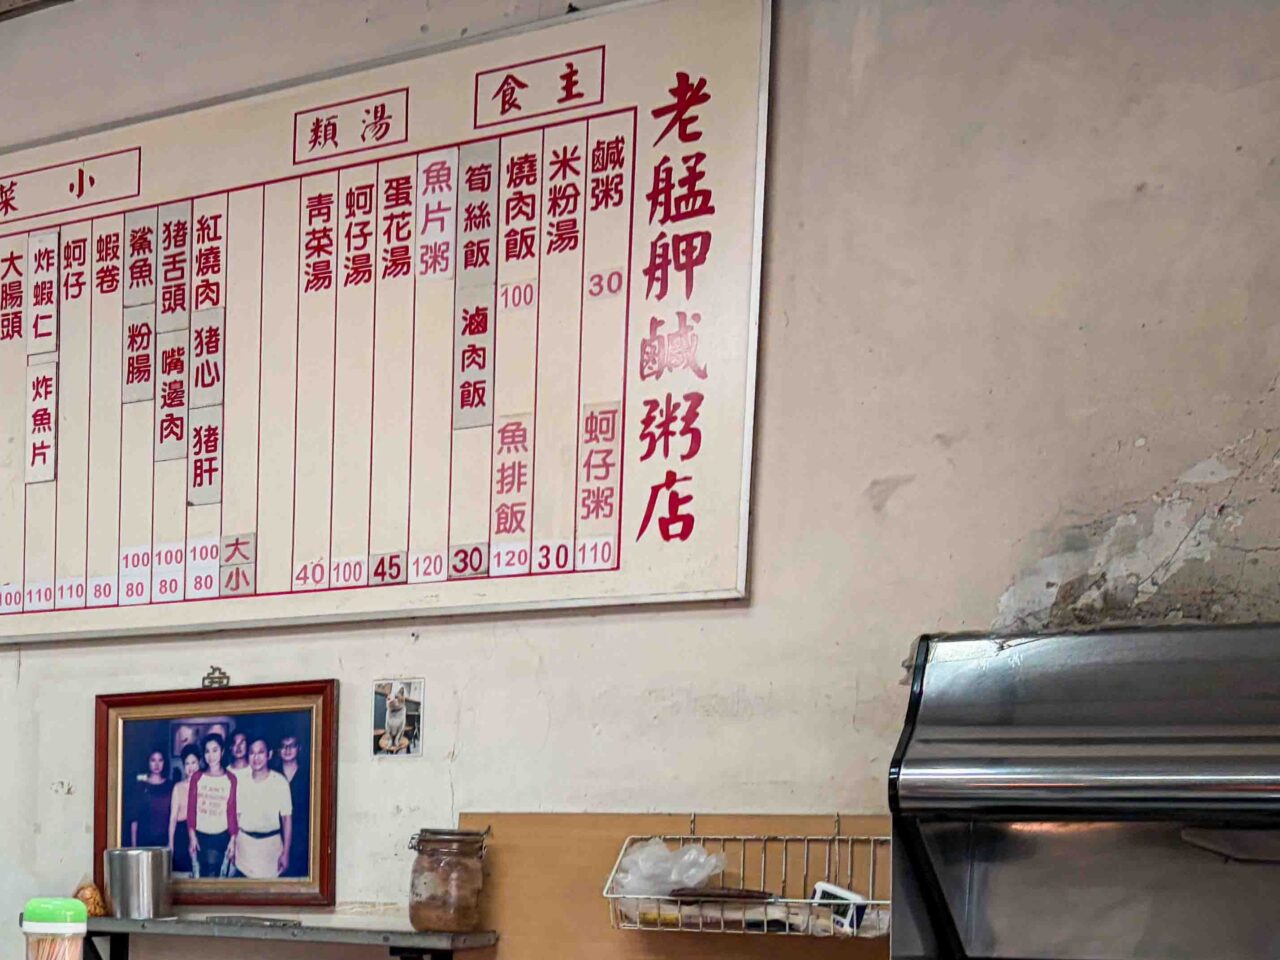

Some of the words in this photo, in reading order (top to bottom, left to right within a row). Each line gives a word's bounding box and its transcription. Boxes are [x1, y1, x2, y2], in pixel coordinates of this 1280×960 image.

[590, 135, 625, 212] 鹹粥
[504, 153, 538, 263] 燒肉飯
[546, 145, 582, 256] 米粉湯
[381, 175, 412, 280] 蛋花湯
[419, 160, 453, 276] 魚片粥
[463, 164, 492, 270] 筍絲飯
[304, 193, 334, 293] 青菜湯
[343, 184, 375, 288] 蚵仔湯
[63, 238, 87, 300] 蚵仔
[129, 226, 154, 289] 鯊魚
[195, 214, 222, 310] 紅燒肉
[0, 251, 23, 340] 大腸頭
[32, 247, 55, 338] 炸蝦仁
[500, 284, 534, 309] 100
[588, 271, 623, 298] 30
[636, 71, 715, 543] 老艋舺鹹粥店
[126, 323, 152, 385] 粉腸
[459, 306, 488, 409] 滷肉飯
[160, 346, 185, 443] 嘴邊肉
[31, 375, 53, 467] 炸魚片
[494, 421, 529, 535] 魚排飯
[581, 409, 618, 520] 蚵仔粥
[122, 551, 150, 569] 100
[155, 548, 183, 565] 100
[190, 544, 218, 562] 100
[224, 537, 250, 563] 大
[452, 547, 483, 573] 30
[493, 549, 528, 568] 120
[538, 544, 569, 570] 30
[577, 541, 612, 564] 110
[224, 567, 250, 591] 小
[295, 563, 325, 586] 40
[332, 561, 363, 584] 100
[373, 555, 401, 582] 45
[411, 555, 443, 578] 120
[26, 587, 52, 603] 110
[57, 583, 84, 599] 110
[93, 583, 112, 598] 80
[125, 582, 144, 597] 80
[159, 578, 178, 594] 80
[194, 575, 213, 591] 80
